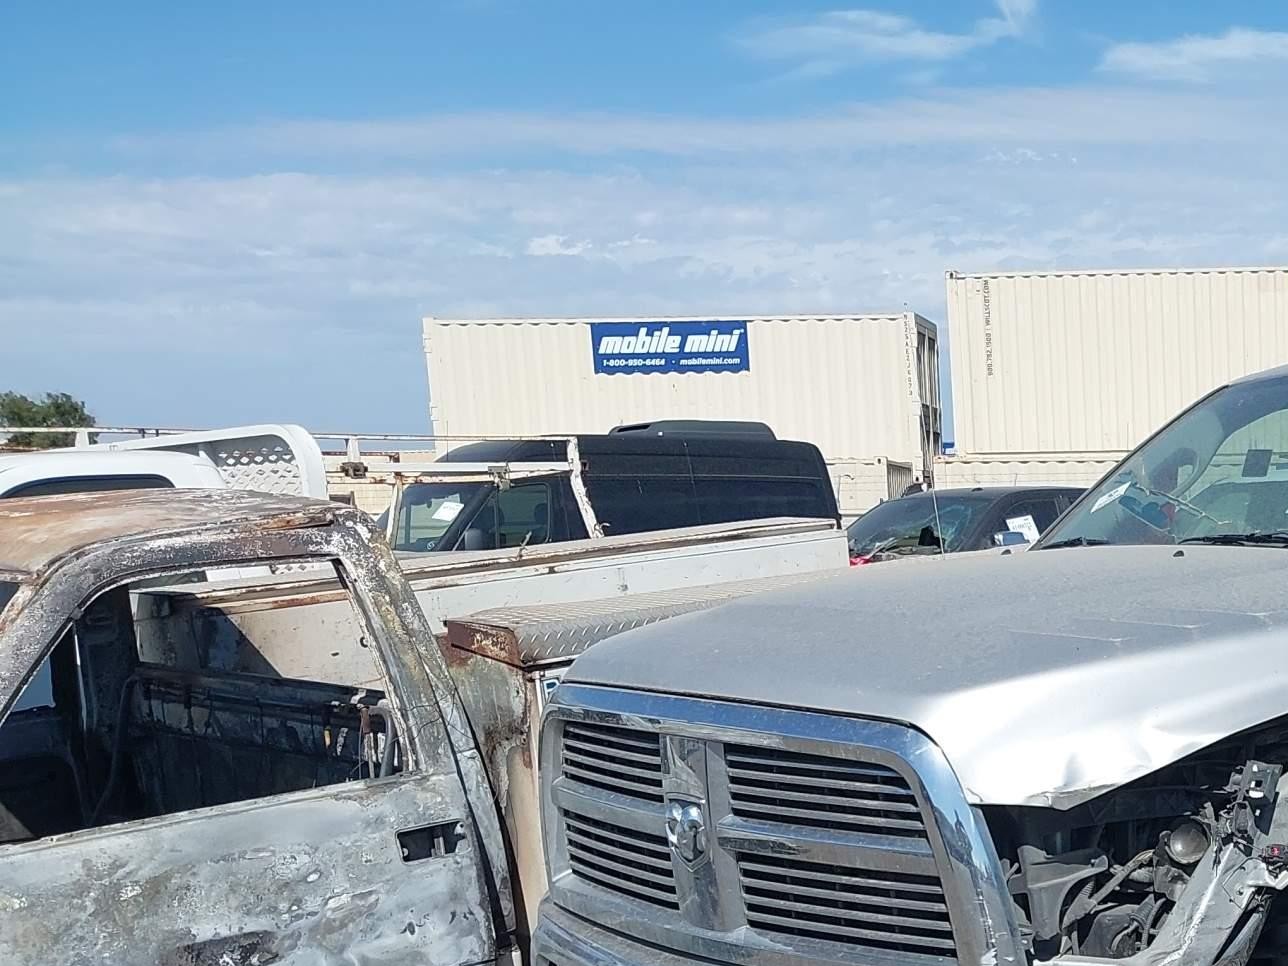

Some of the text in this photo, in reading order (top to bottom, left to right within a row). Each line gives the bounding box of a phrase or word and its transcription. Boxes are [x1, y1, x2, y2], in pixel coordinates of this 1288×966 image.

[598, 326, 742, 354] mobile mini
[603, 357, 741, 367] 1-800-950-6464 mobilemini.com
